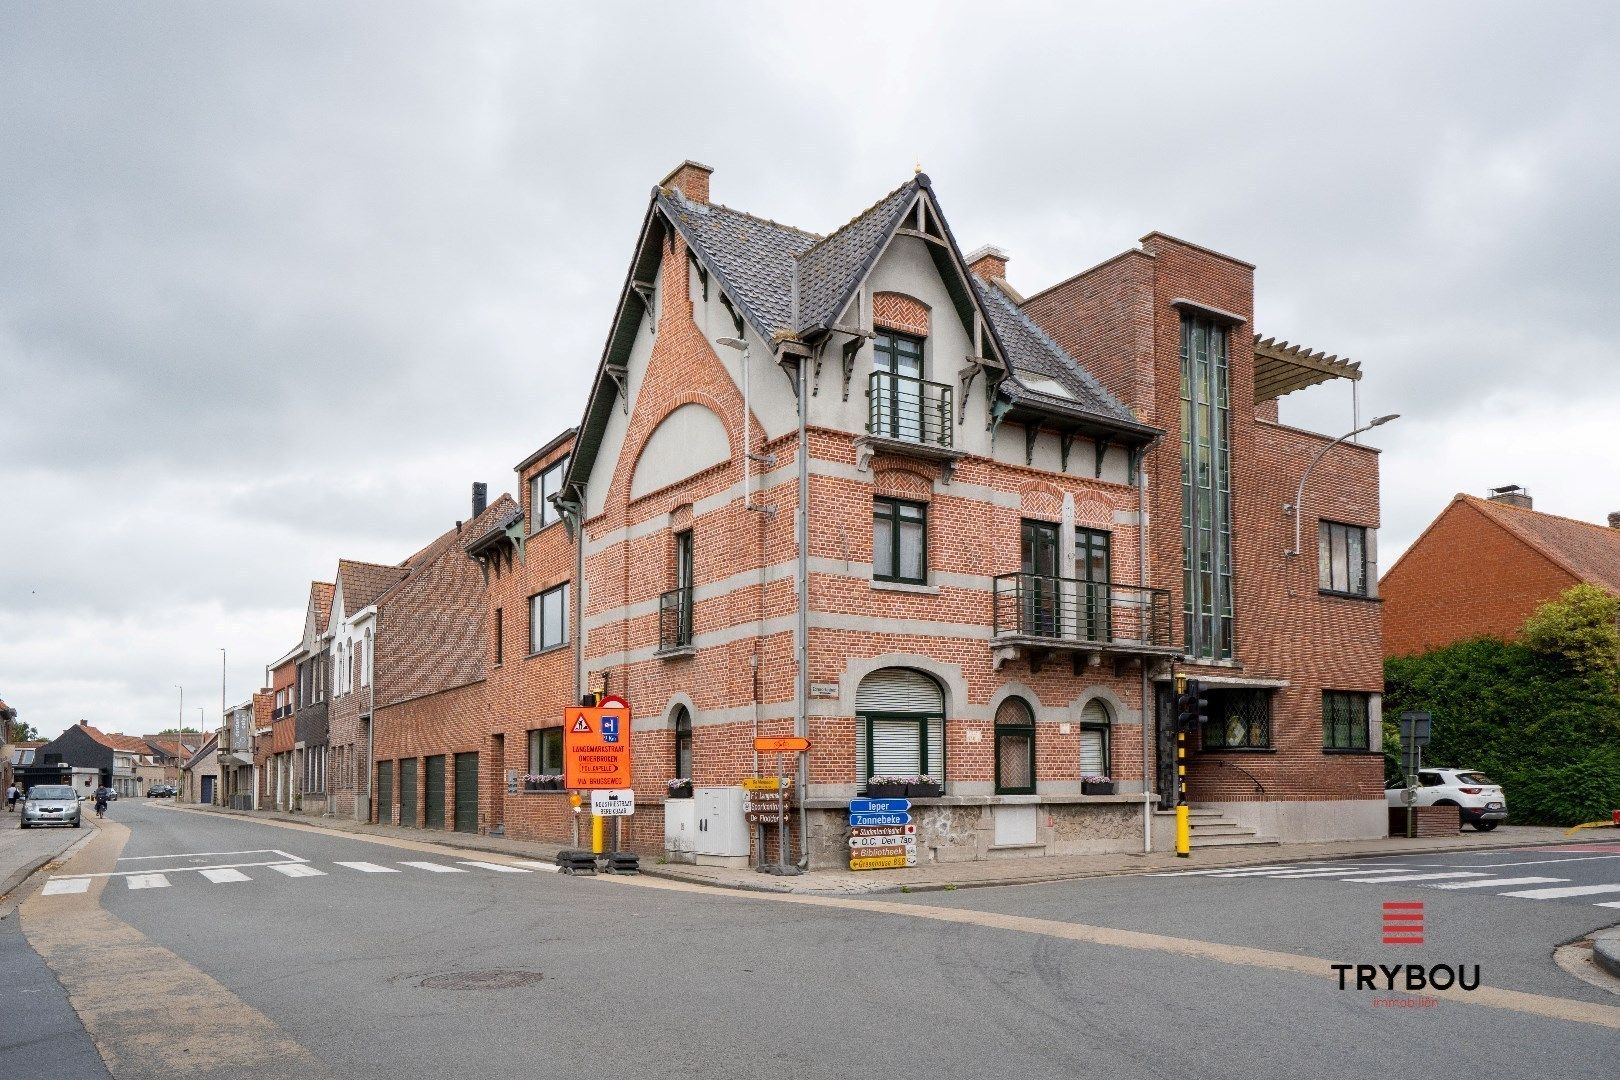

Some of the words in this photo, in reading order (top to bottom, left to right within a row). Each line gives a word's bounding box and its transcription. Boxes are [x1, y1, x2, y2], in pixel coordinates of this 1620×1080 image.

[868, 801, 890, 812] Ieper
[857, 815, 901, 825] Zonnebeke
[881, 837, 896, 845] Den
[860, 847, 903, 857] Bibliotheek
